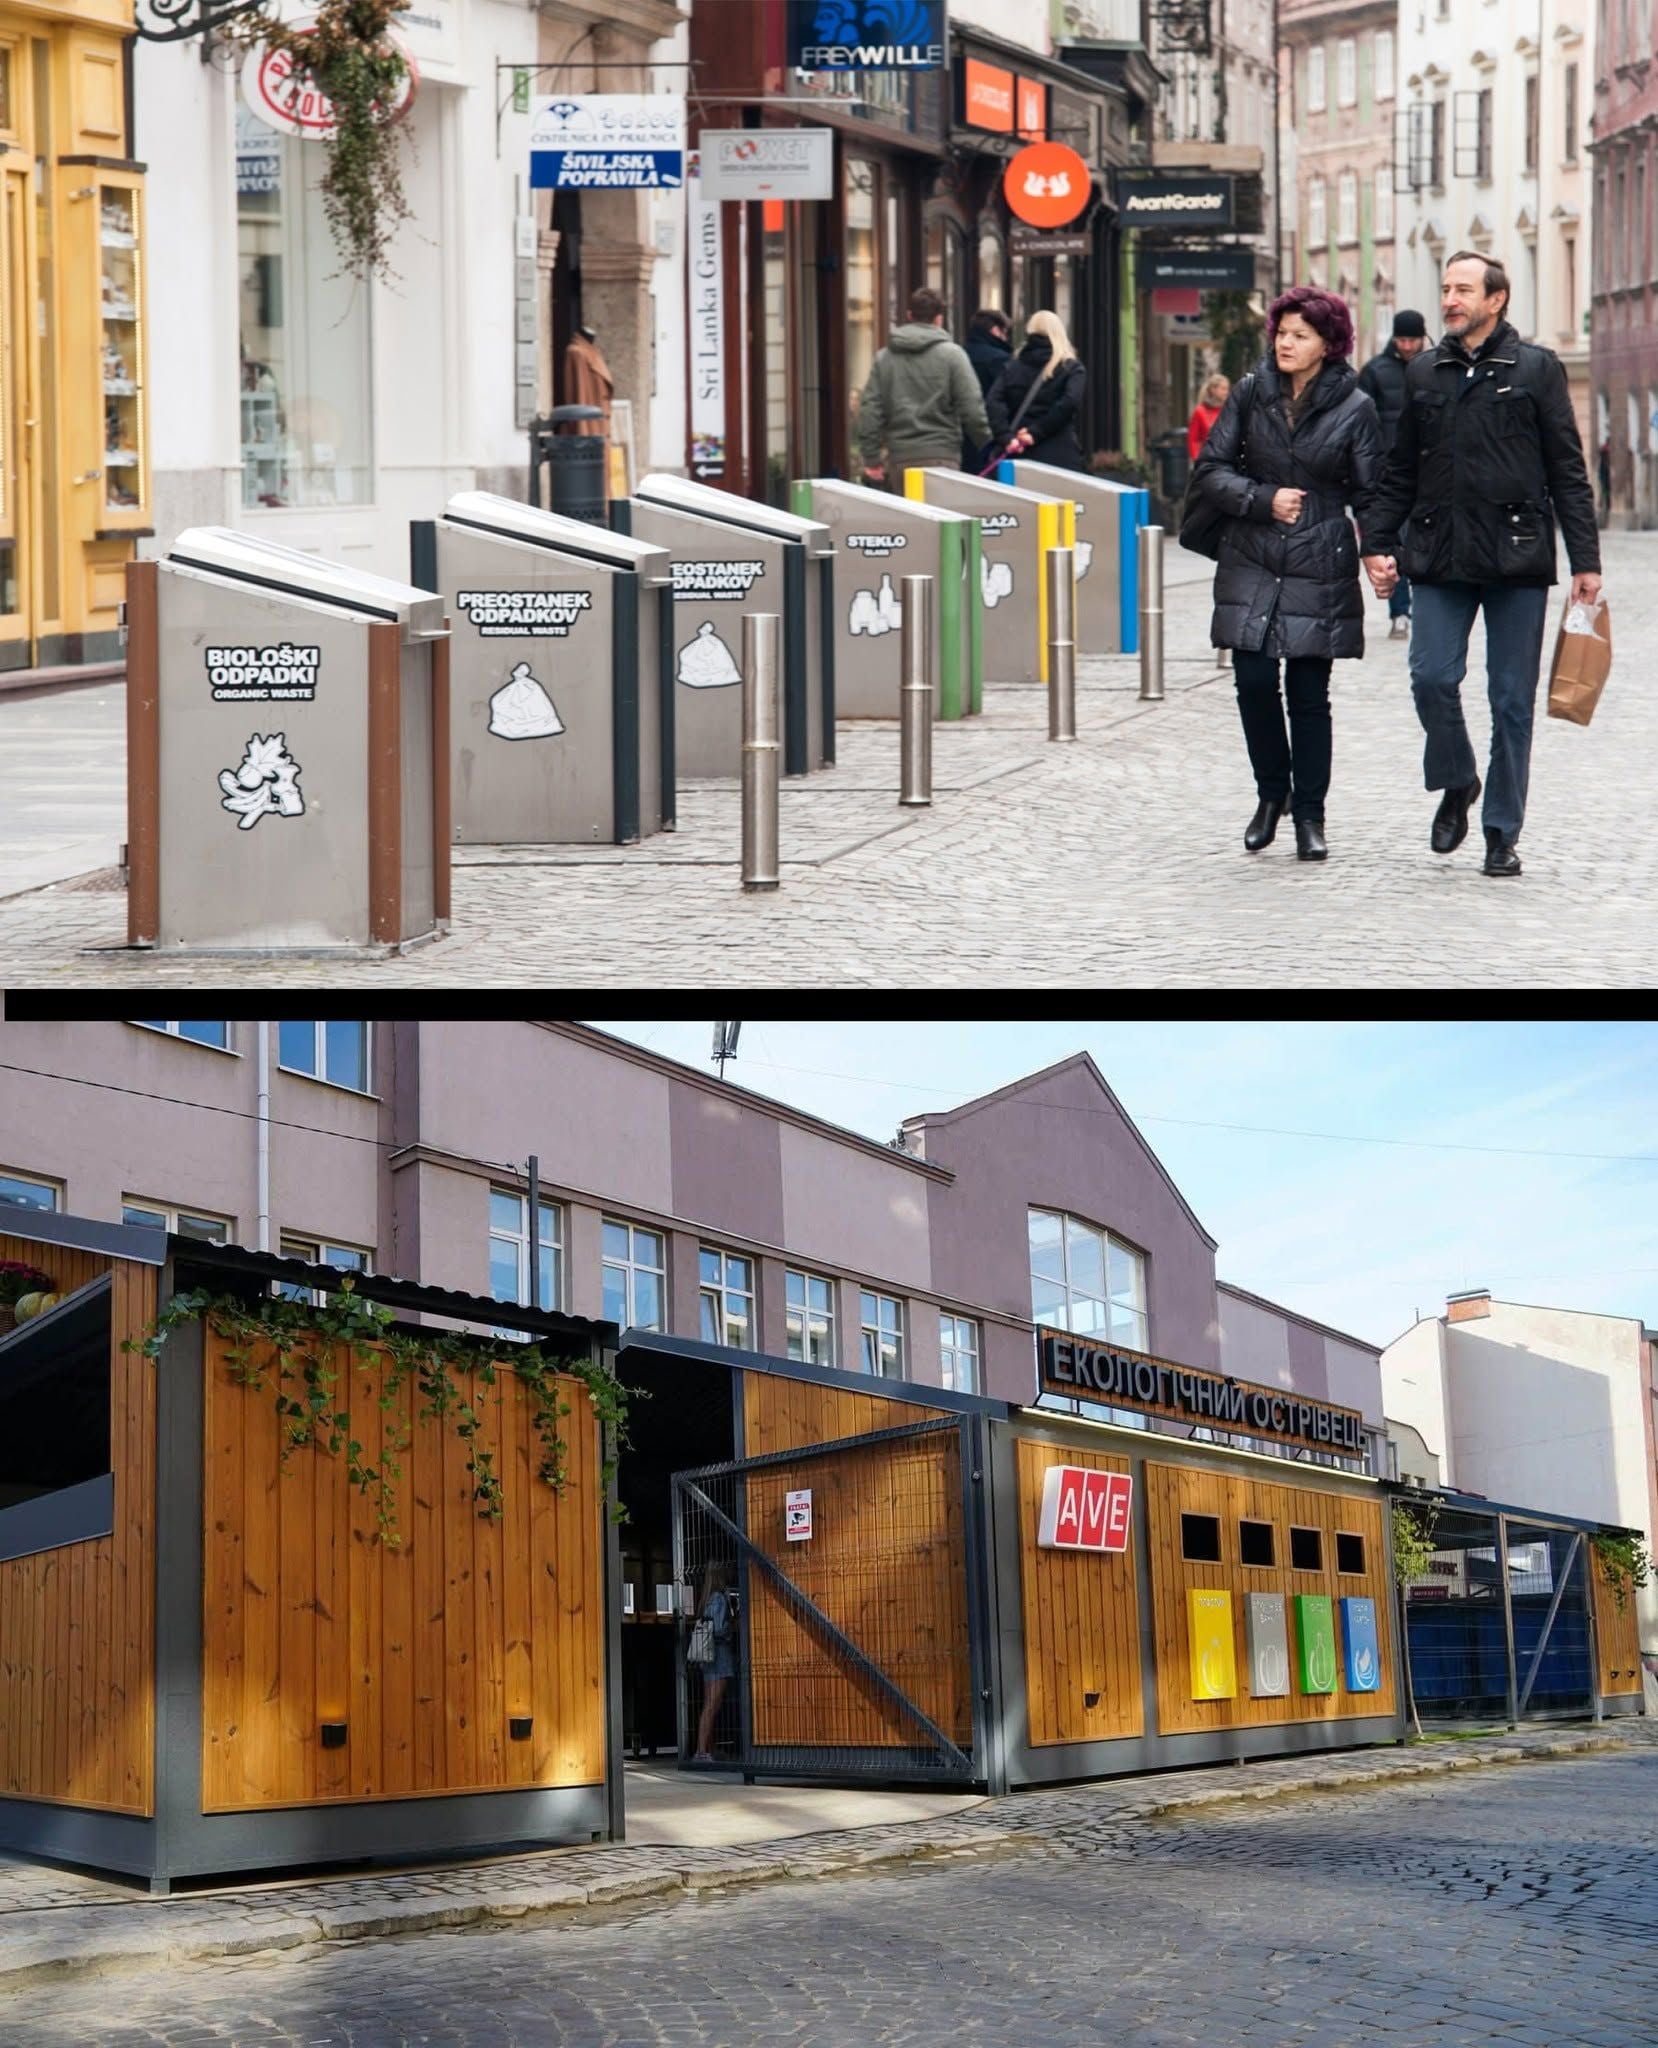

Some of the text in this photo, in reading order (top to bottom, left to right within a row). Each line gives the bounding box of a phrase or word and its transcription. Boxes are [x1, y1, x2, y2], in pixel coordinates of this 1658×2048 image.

[801, 44, 943, 66] FREYWILLE
[557, 150, 660, 187] ŠIVILJSKA POPRAVILA
[1126, 193, 1224, 212] AvantGarde
[696, 211, 719, 400] Sri Lanka Gems
[979, 513, 1019, 529] LAŽA
[847, 534, 907, 548] STEKLO
[672, 561, 764, 576] EOSTANEK
[673, 575, 755, 590] DPADKOV
[458, 592, 591, 609] PREOSTANEK
[673, 591, 712, 600] ESIDUAL
[469, 608, 580, 624] ODPADKOV
[481, 626, 568, 636] RESIDUAL WASTE
[207, 644, 319, 667] BIOLOŠKI
[210, 666, 316, 685] ODPADKI
[213, 688, 314, 700] ORGANIC WASTE
[1052, 1339, 1371, 1451] ЕКОЛОГІЧНИЙ ОСТРІВЕЦЬ
[1059, 1487, 1128, 1532] AVE
